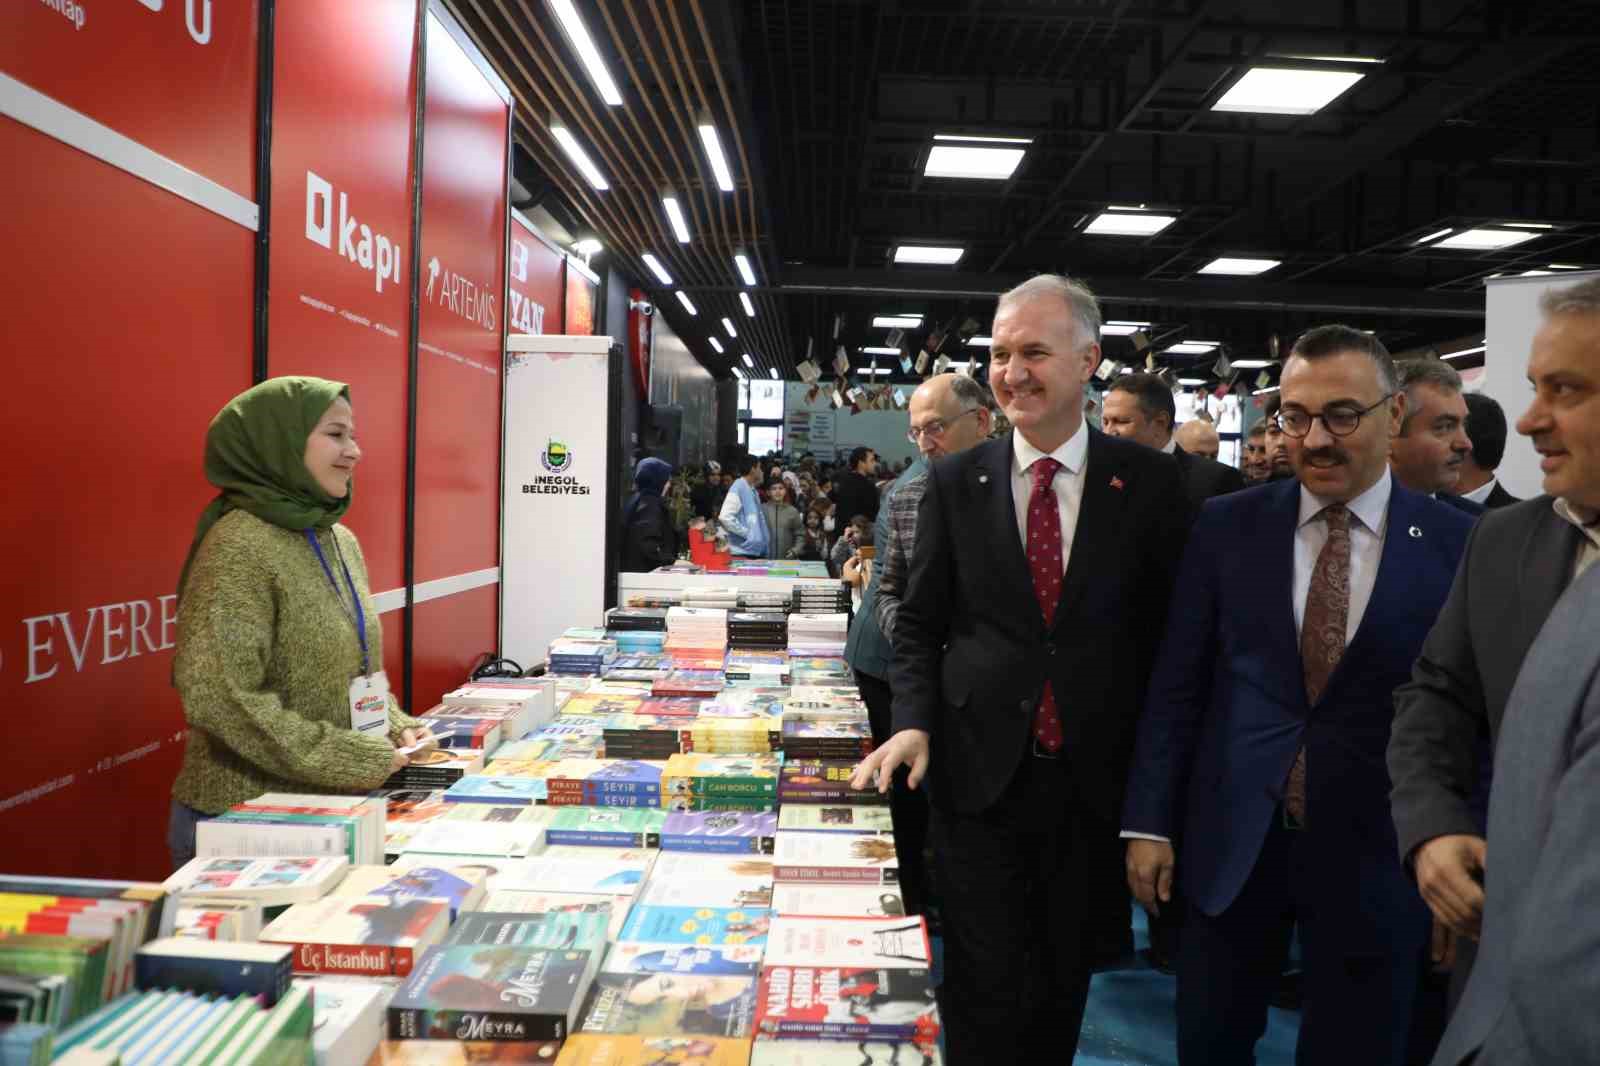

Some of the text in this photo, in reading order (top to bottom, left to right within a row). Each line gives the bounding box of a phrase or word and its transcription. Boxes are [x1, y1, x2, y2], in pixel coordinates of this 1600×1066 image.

[338, 191, 401, 293] kapı
[439, 268, 496, 331] ARTEMİS
[300, 943, 385, 971] Üç İstanbul
[456, 1014, 527, 1041] MEYRA
